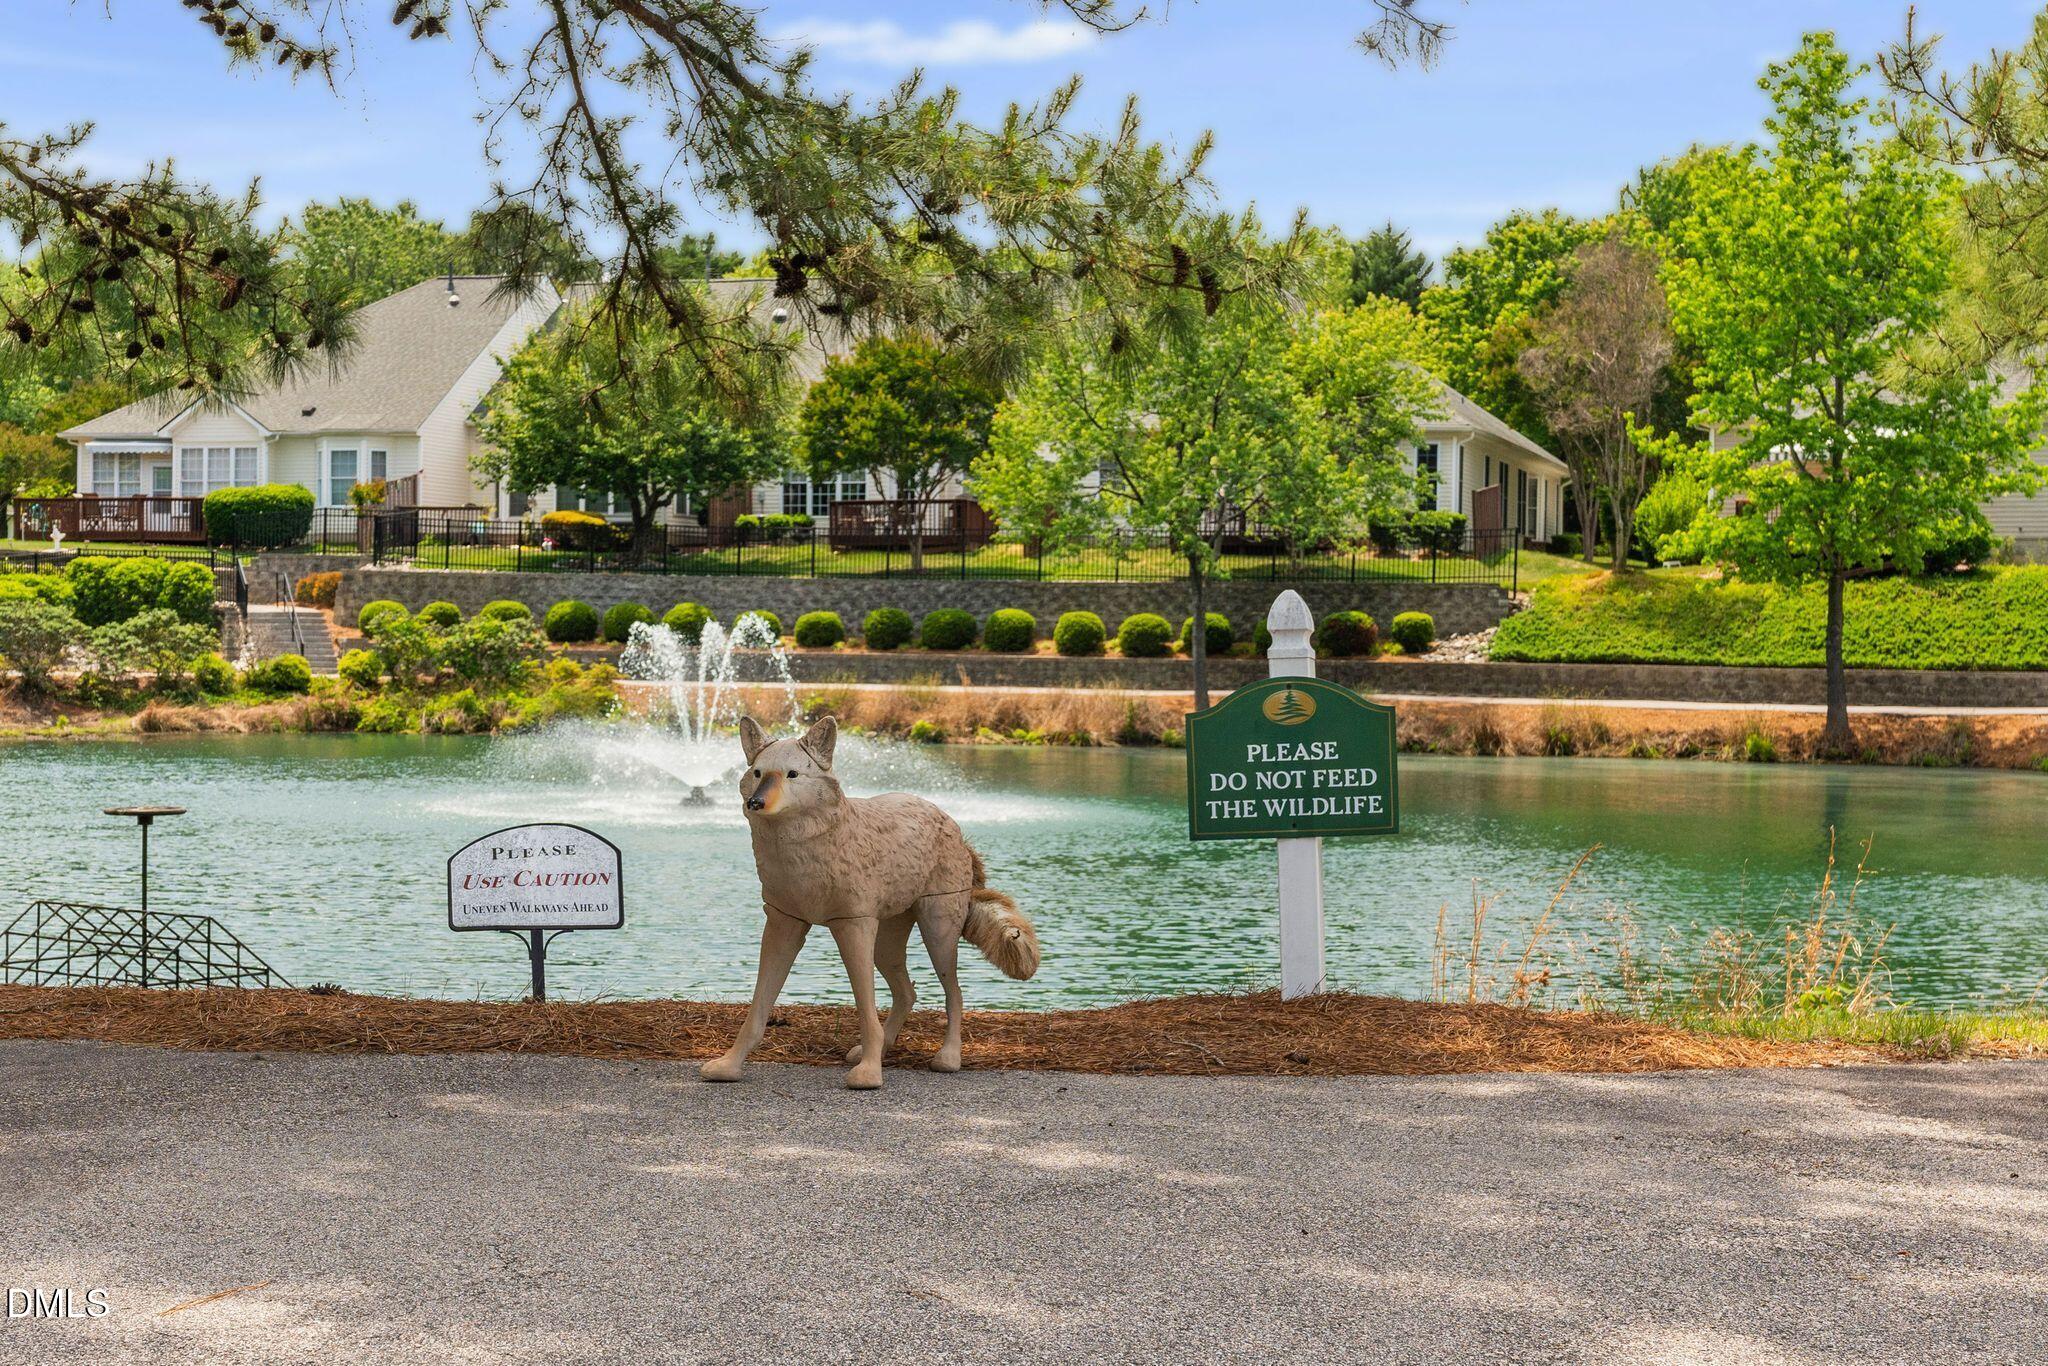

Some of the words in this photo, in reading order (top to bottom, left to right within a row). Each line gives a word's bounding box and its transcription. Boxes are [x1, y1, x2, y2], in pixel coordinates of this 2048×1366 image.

[1246, 741, 1339, 763] PLEASE
[1209, 772, 1248, 792] DO
[1255, 770, 1307, 790] NOT
[1312, 768, 1378, 789] FEED
[1205, 799, 1258, 819] THE
[1262, 795, 1384, 817] WILDLIFE
[491, 844, 577, 860] PLEASE
[463, 873, 506, 890] USE
[513, 869, 613, 887] CAUTION
[463, 903, 507, 915] UNEVEN
[509, 901, 569, 914] WALKWAYS
[571, 901, 609, 913] AHEAD
